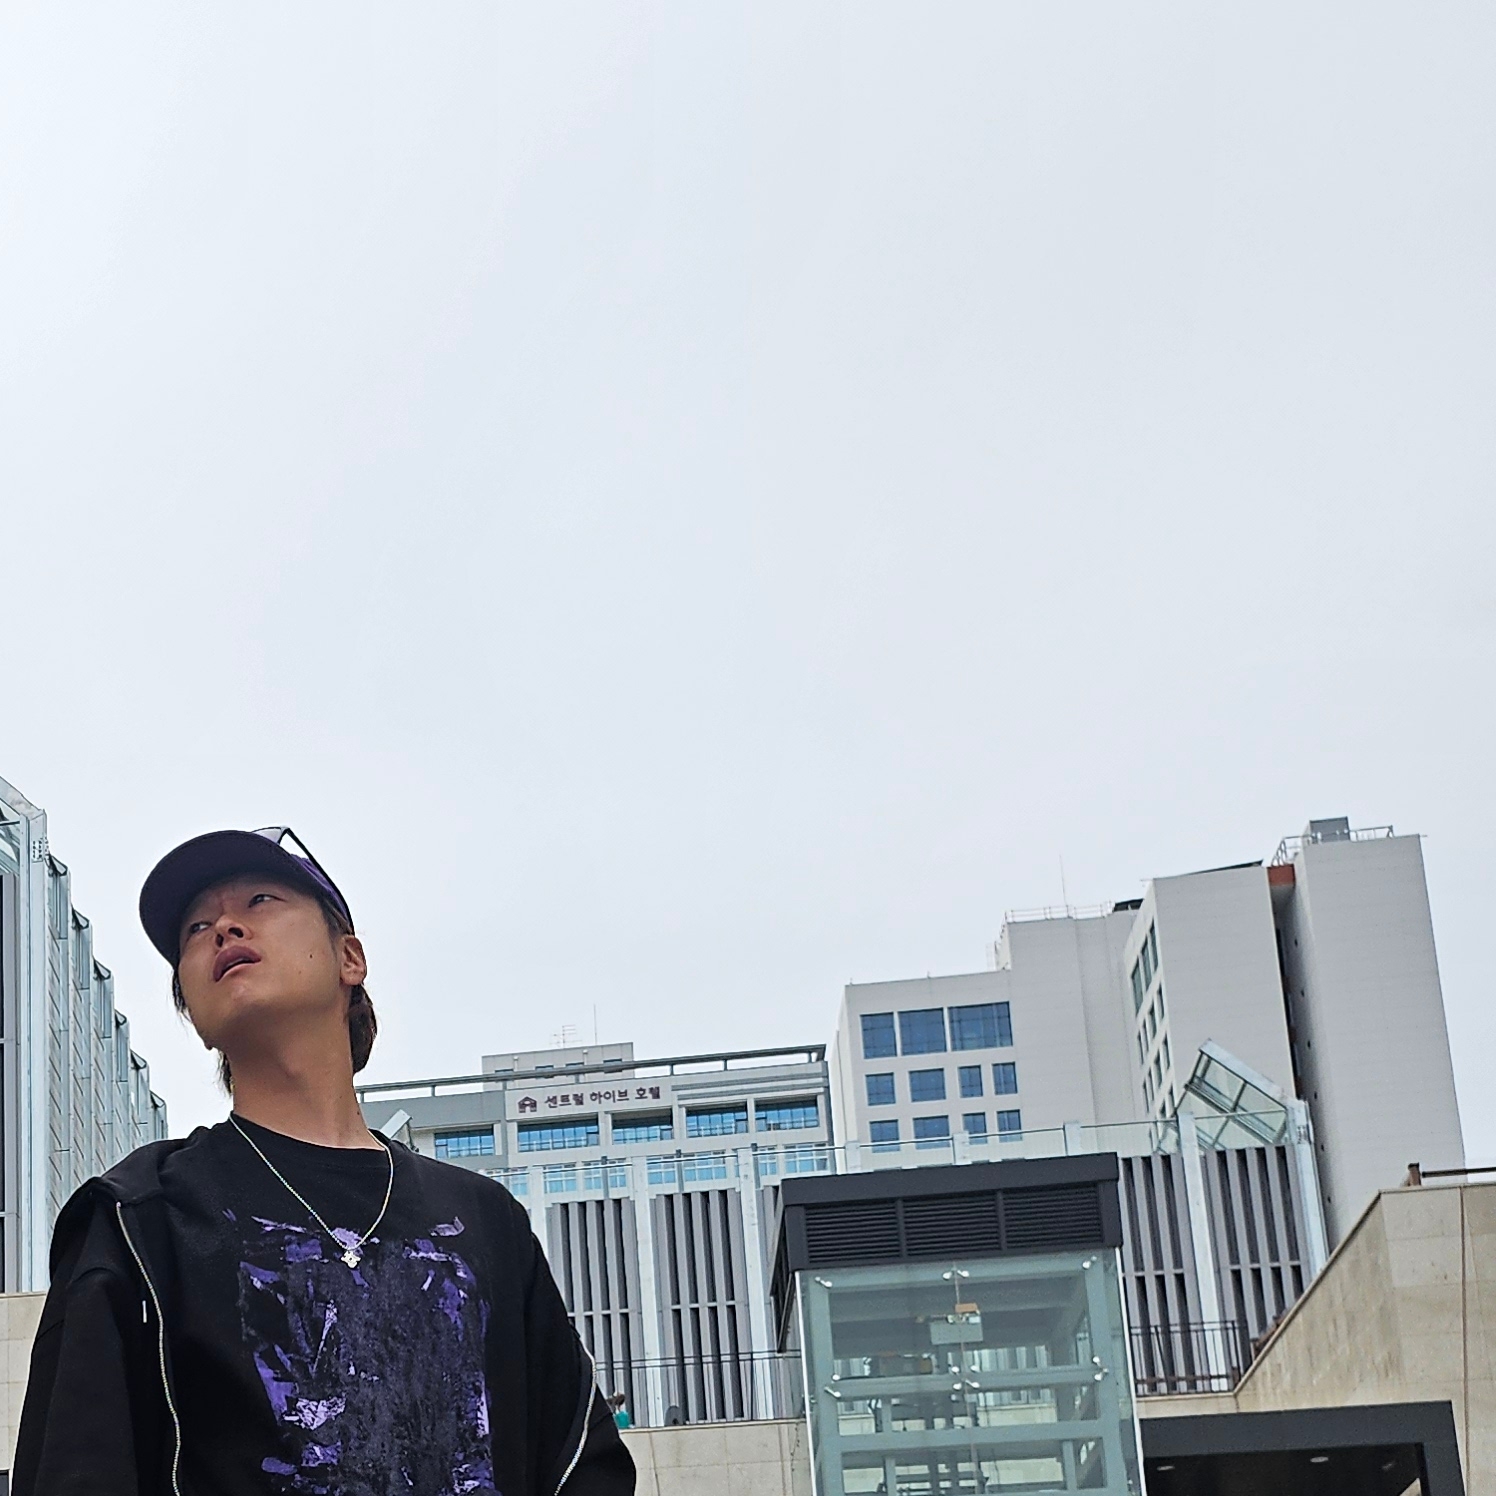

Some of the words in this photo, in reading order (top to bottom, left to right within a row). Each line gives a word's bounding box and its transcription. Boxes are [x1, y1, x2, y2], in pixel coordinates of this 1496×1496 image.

[544, 1092, 584, 1109] 센트럴
[589, 1089, 630, 1105] 하이브
[634, 1086, 661, 1100] 호텔
